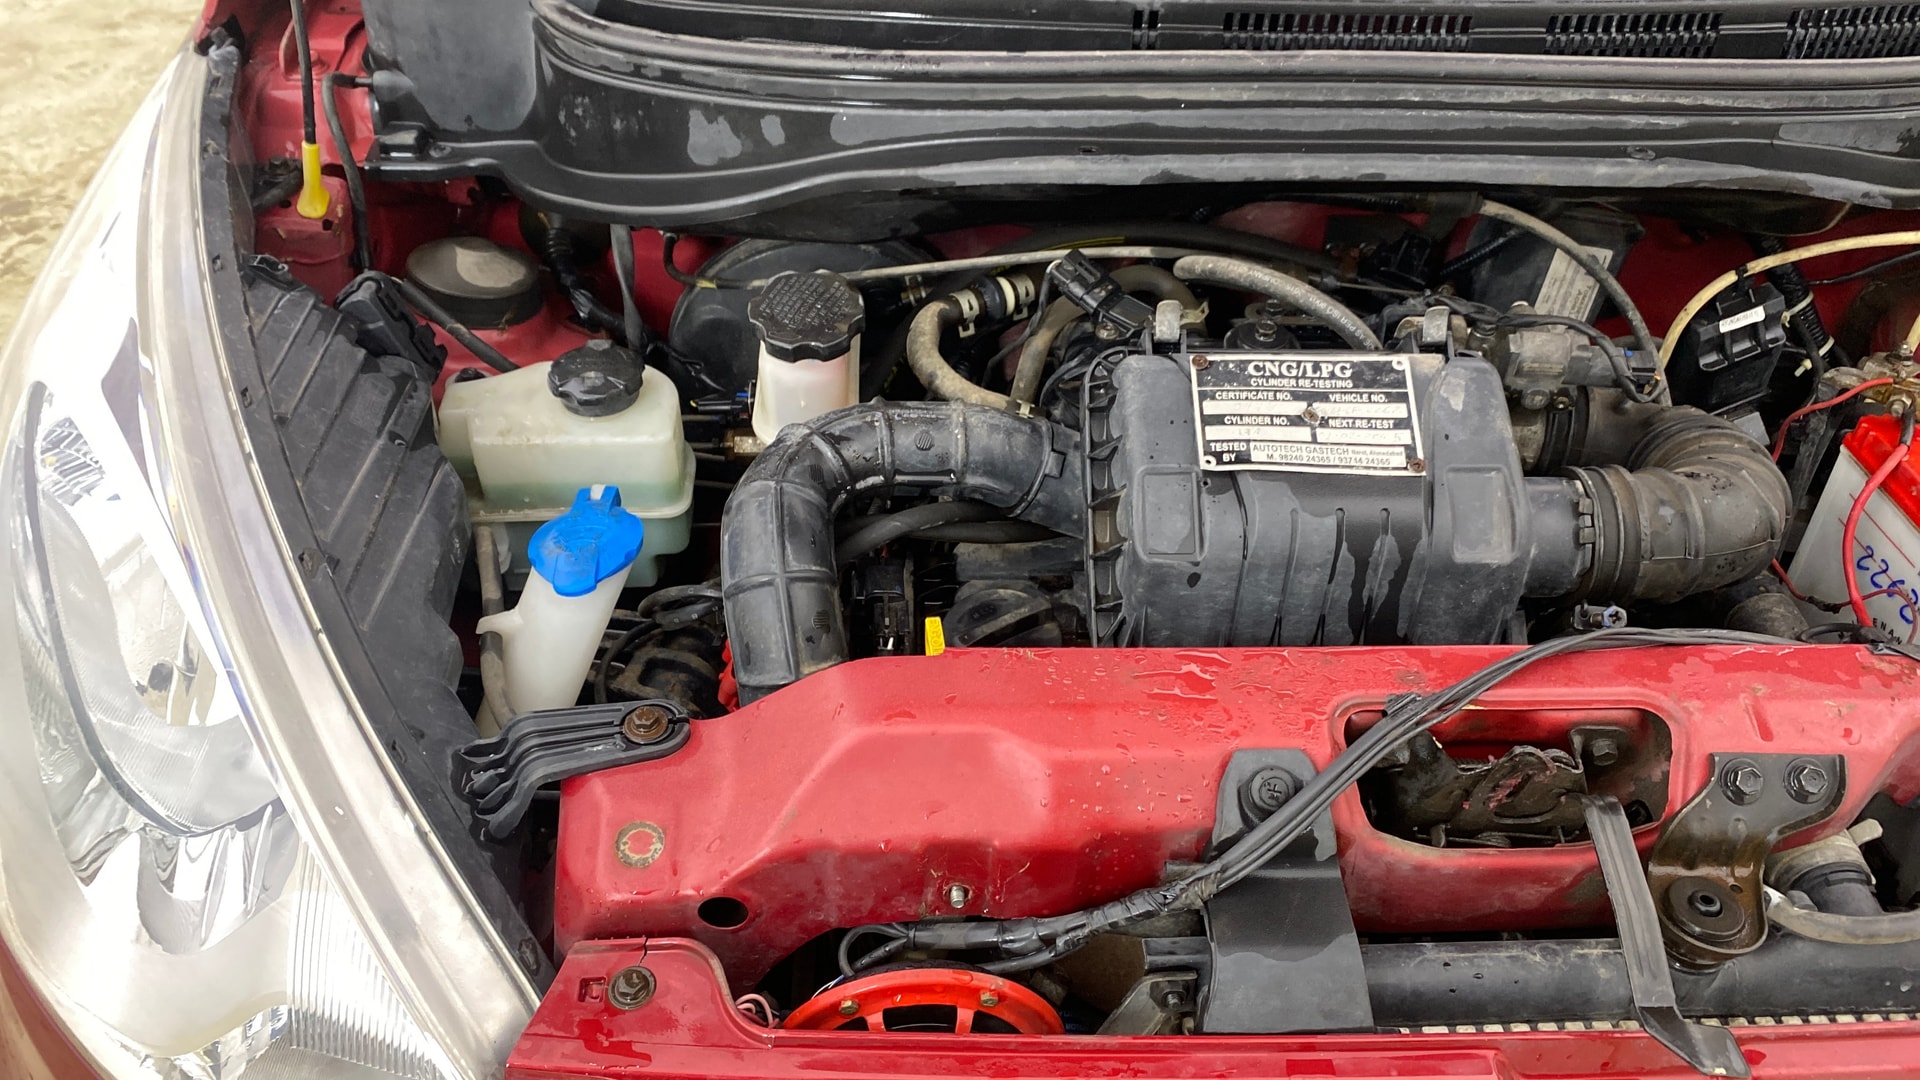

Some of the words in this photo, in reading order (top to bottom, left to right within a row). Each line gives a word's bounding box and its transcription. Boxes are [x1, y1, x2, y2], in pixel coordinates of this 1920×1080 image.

[1248, 360, 1353, 378] CNG/LPG
[1250, 378, 1296, 388] CYLINDER
[1298, 378, 1354, 389] RE-TESTING
[1215, 391, 1275, 400] CERTIFICATE
[1276, 391, 1293, 401] NO.
[1328, 393, 1370, 402] VEHICLE
[1370, 394, 1388, 403] NO.
[1224, 415, 1271, 425] CYLINDER
[1273, 416, 1290, 426] NO.
[1328, 418, 1353, 428] NEXT
[1355, 419, 1394, 429] RE-TEST
[1209, 442, 1247, 452] TESTED
[1252, 444, 1303, 453] AUTOTECH
[1305, 446, 1349, 456] GASTECH
[1222, 452, 1236, 462] BY
